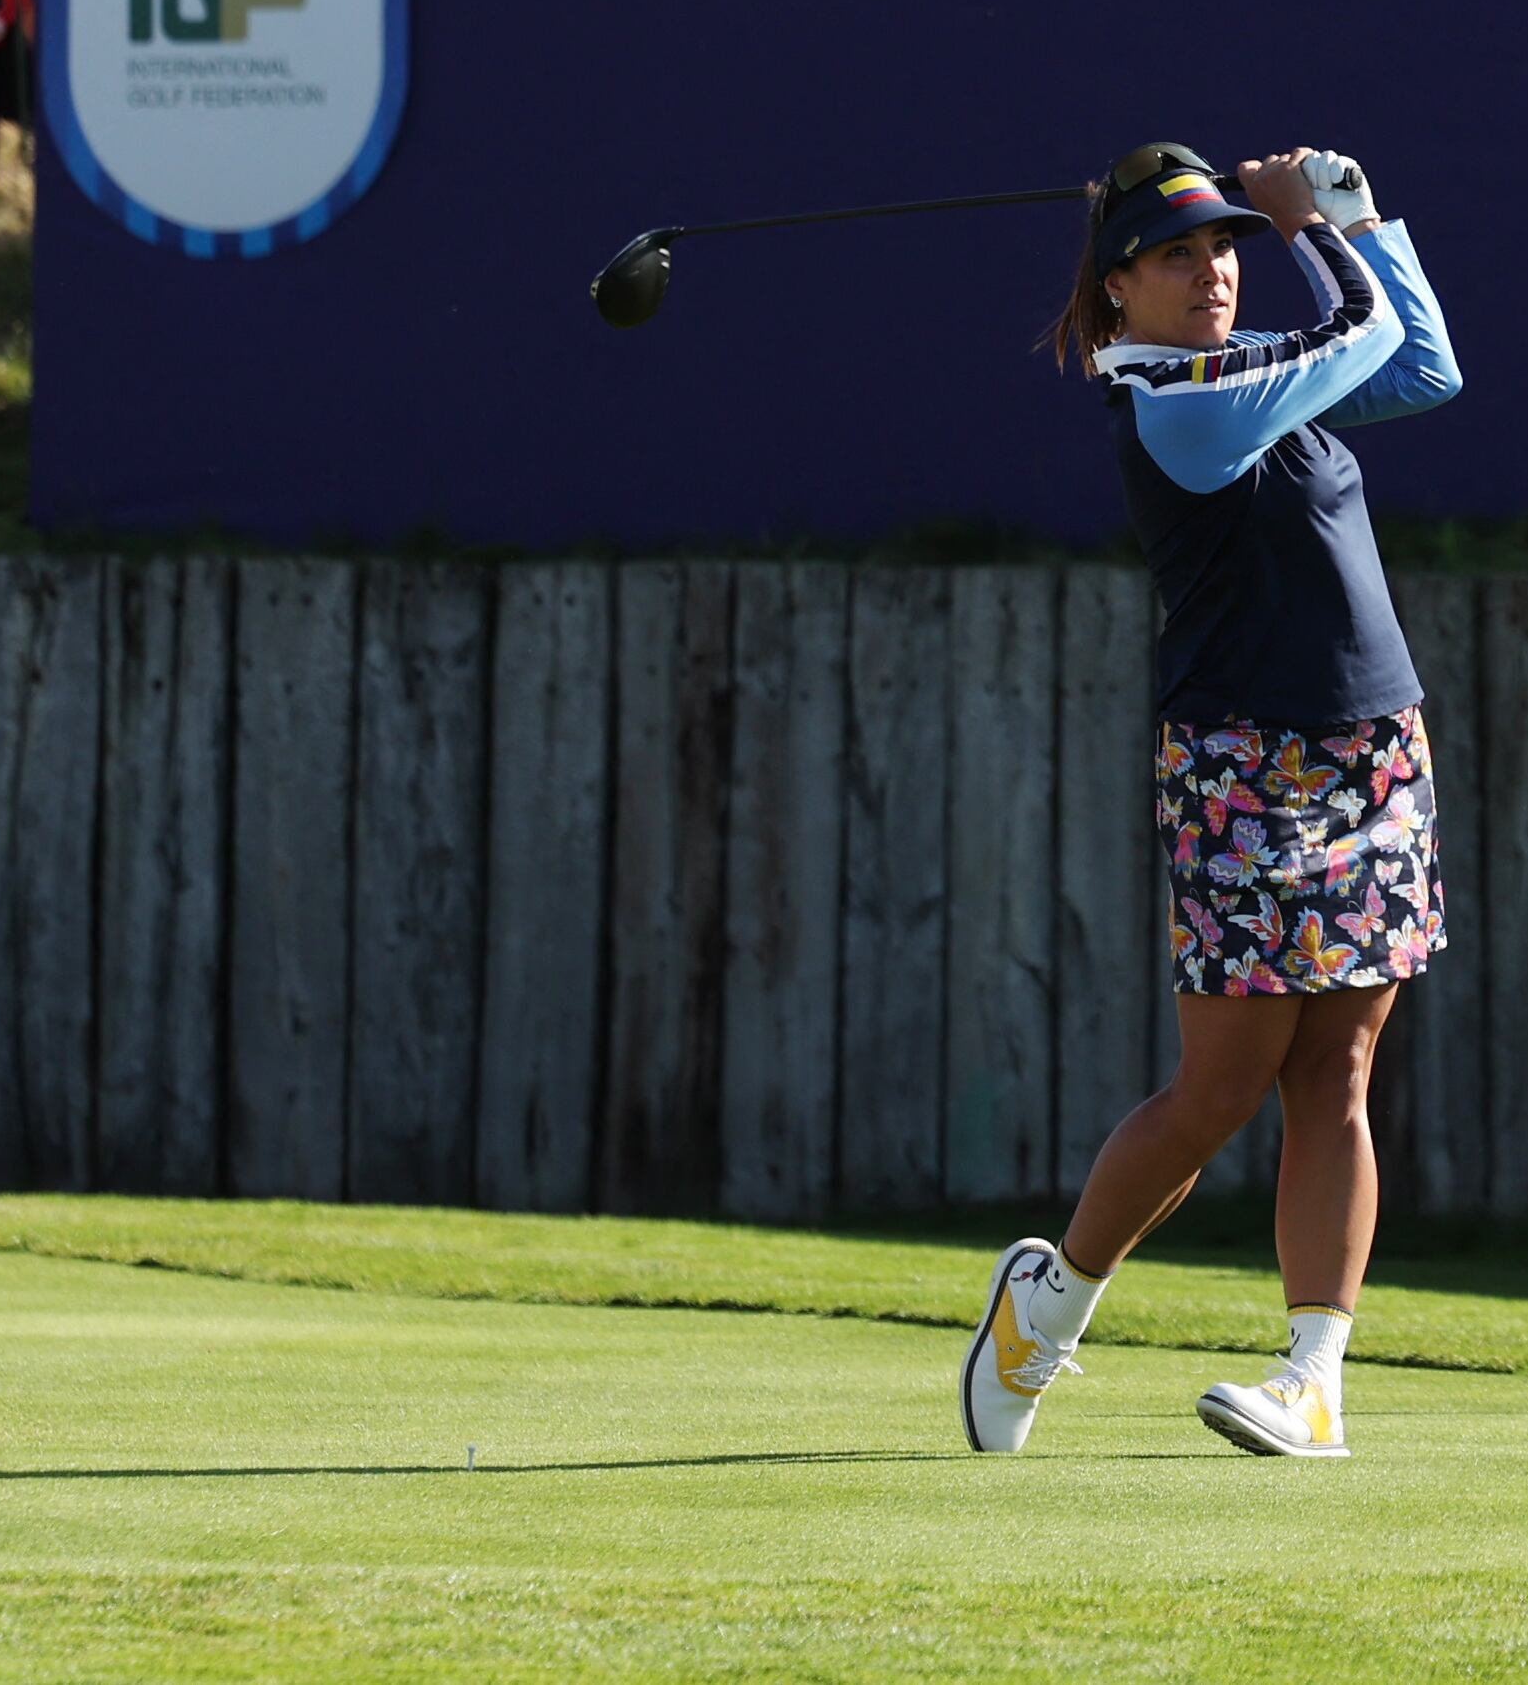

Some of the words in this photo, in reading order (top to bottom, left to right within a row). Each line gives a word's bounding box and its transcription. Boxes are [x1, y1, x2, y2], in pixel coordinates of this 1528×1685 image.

[128, 59, 290, 77] INTERNATIONAL
[128, 86, 183, 106] GOLF
[192, 86, 325, 106] FEDERATION
